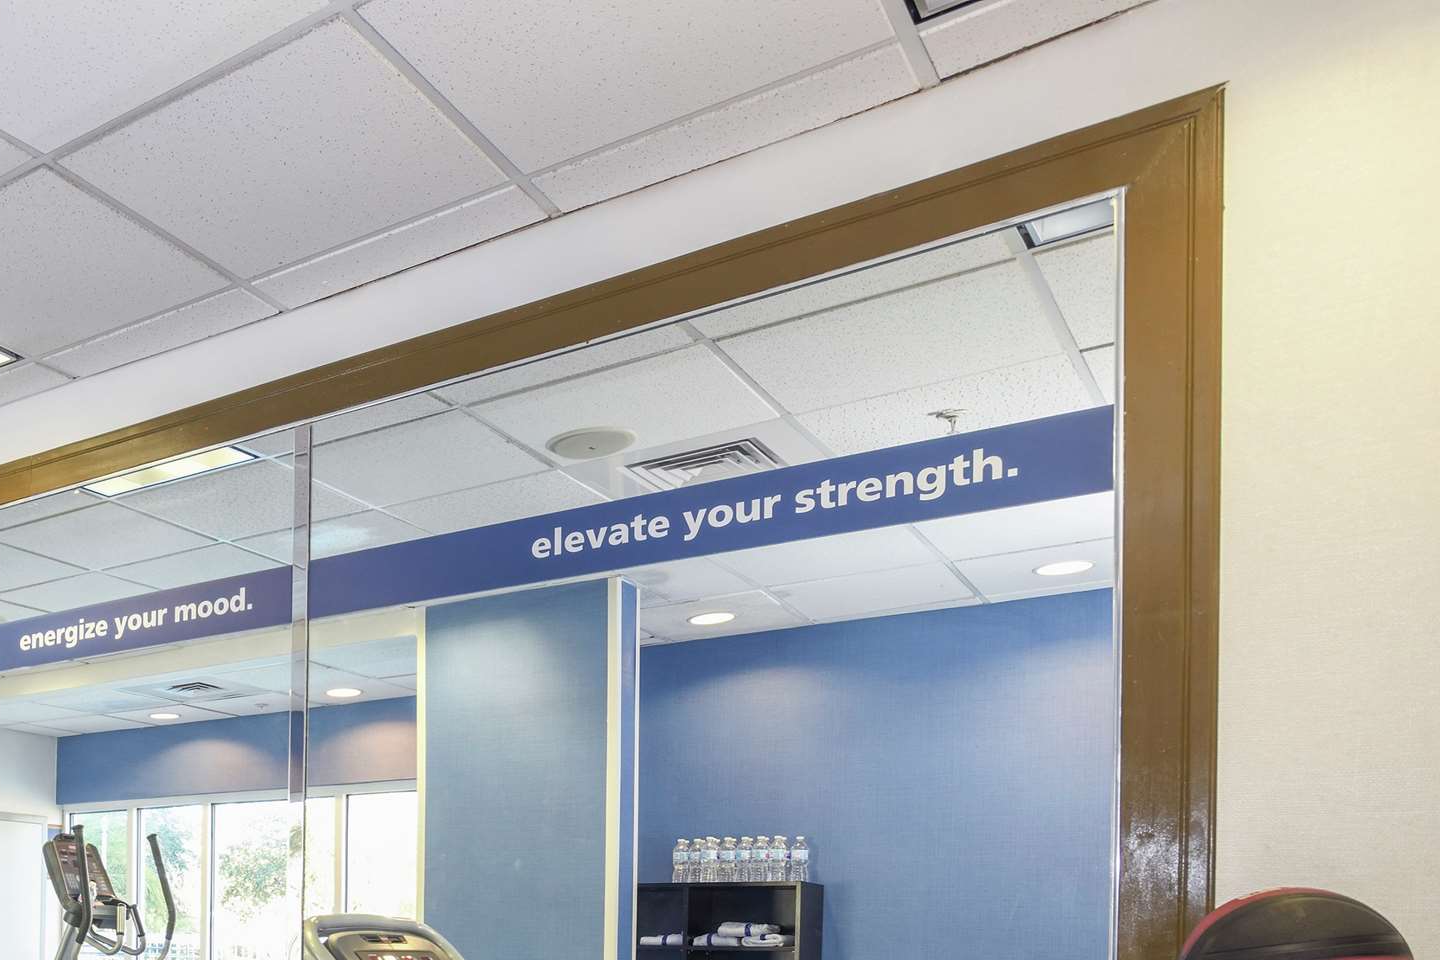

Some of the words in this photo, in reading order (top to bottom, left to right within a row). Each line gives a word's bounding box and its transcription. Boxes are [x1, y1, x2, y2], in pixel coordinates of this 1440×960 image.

[531, 513, 670, 559] elevate
[682, 492, 781, 541] your
[795, 448, 1019, 514] strength.
[19, 618, 108, 651] energize
[114, 607, 168, 639] your
[174, 587, 253, 623] mood.
